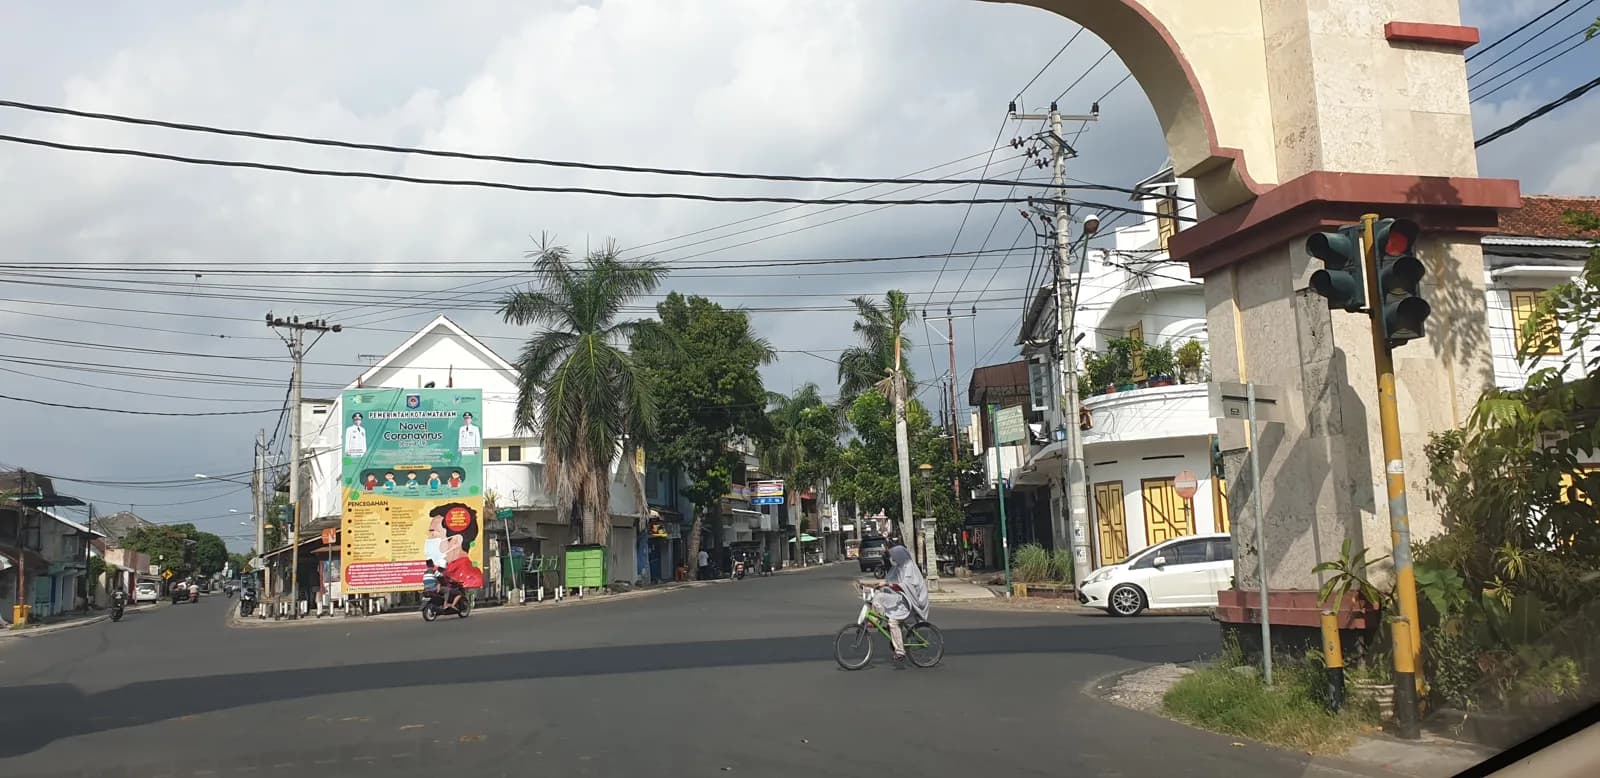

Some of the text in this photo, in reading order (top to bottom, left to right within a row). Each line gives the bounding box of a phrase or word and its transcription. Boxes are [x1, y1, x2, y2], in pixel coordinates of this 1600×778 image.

[368, 411, 408, 419] PEMERINTAH
[427, 410, 457, 418] MATARAM
[399, 421, 428, 431] Novel
[384, 431, 443, 441] Coronavirus
